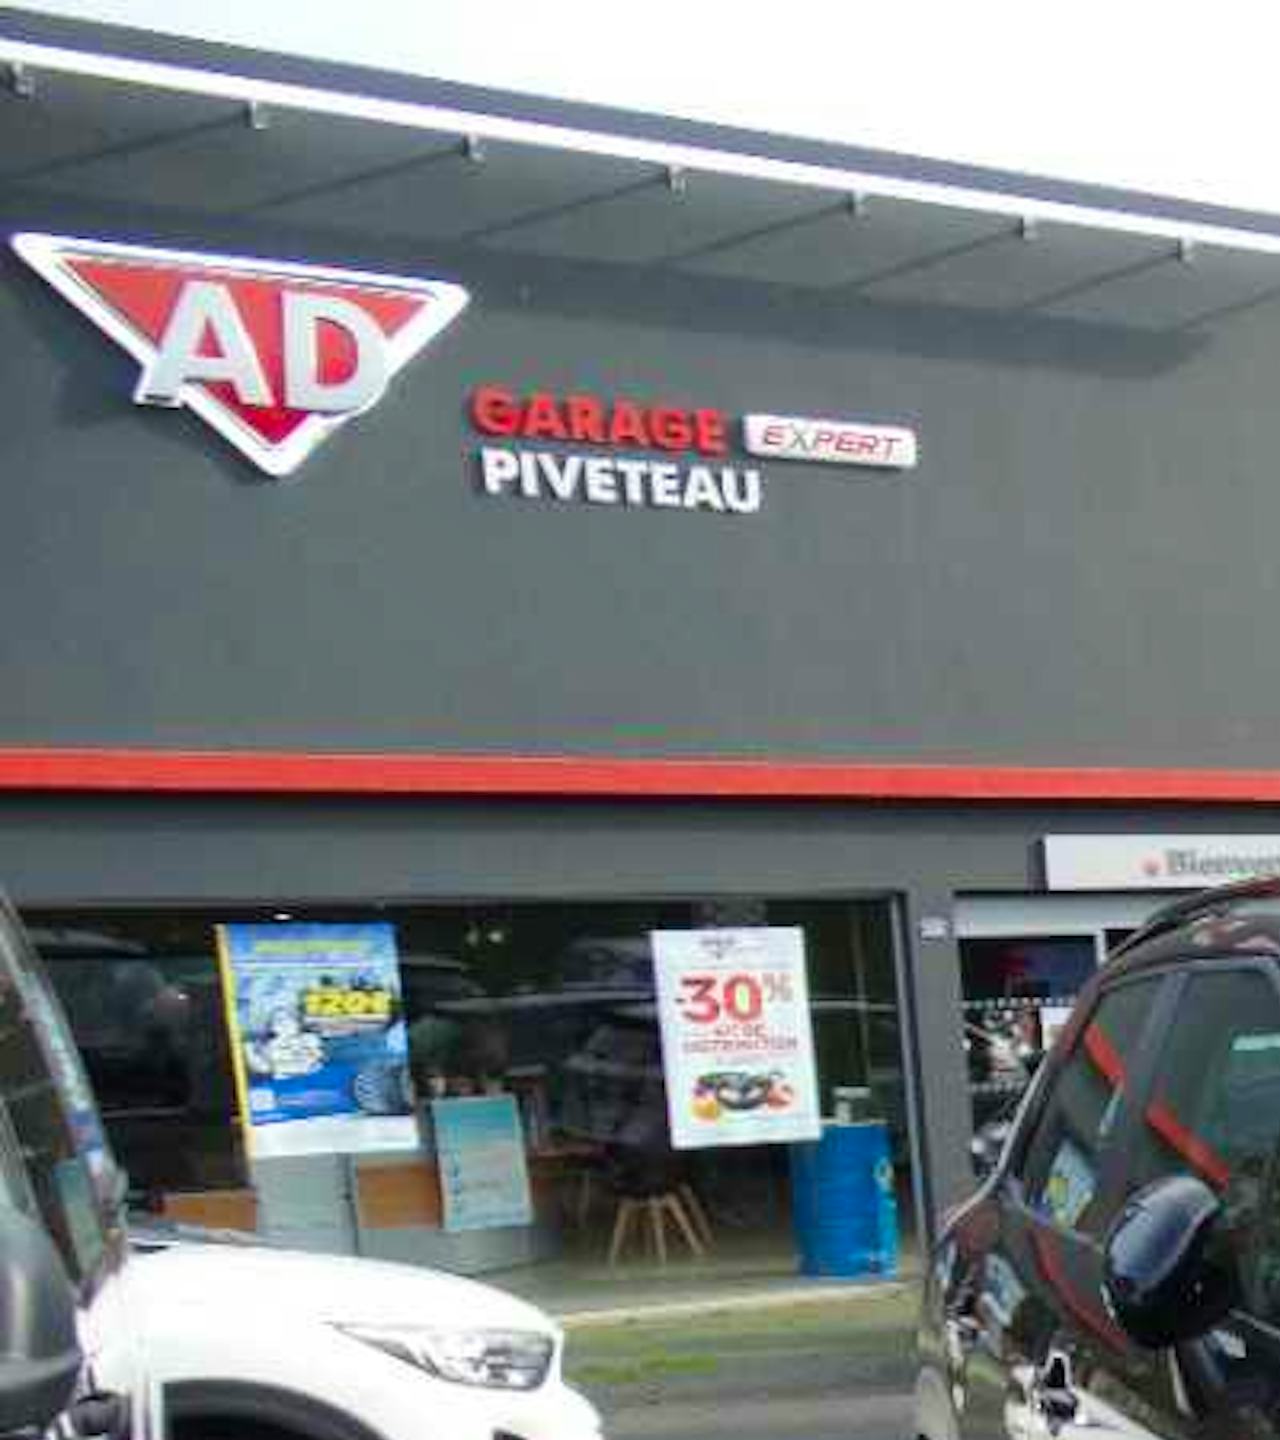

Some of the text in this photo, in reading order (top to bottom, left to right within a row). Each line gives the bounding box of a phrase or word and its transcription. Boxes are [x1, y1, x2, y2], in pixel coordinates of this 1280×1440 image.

[136, 280, 391, 413] AD
[472, 386, 902, 458] GARAGE EXPERT
[481, 446, 762, 513] PIVETEAU
